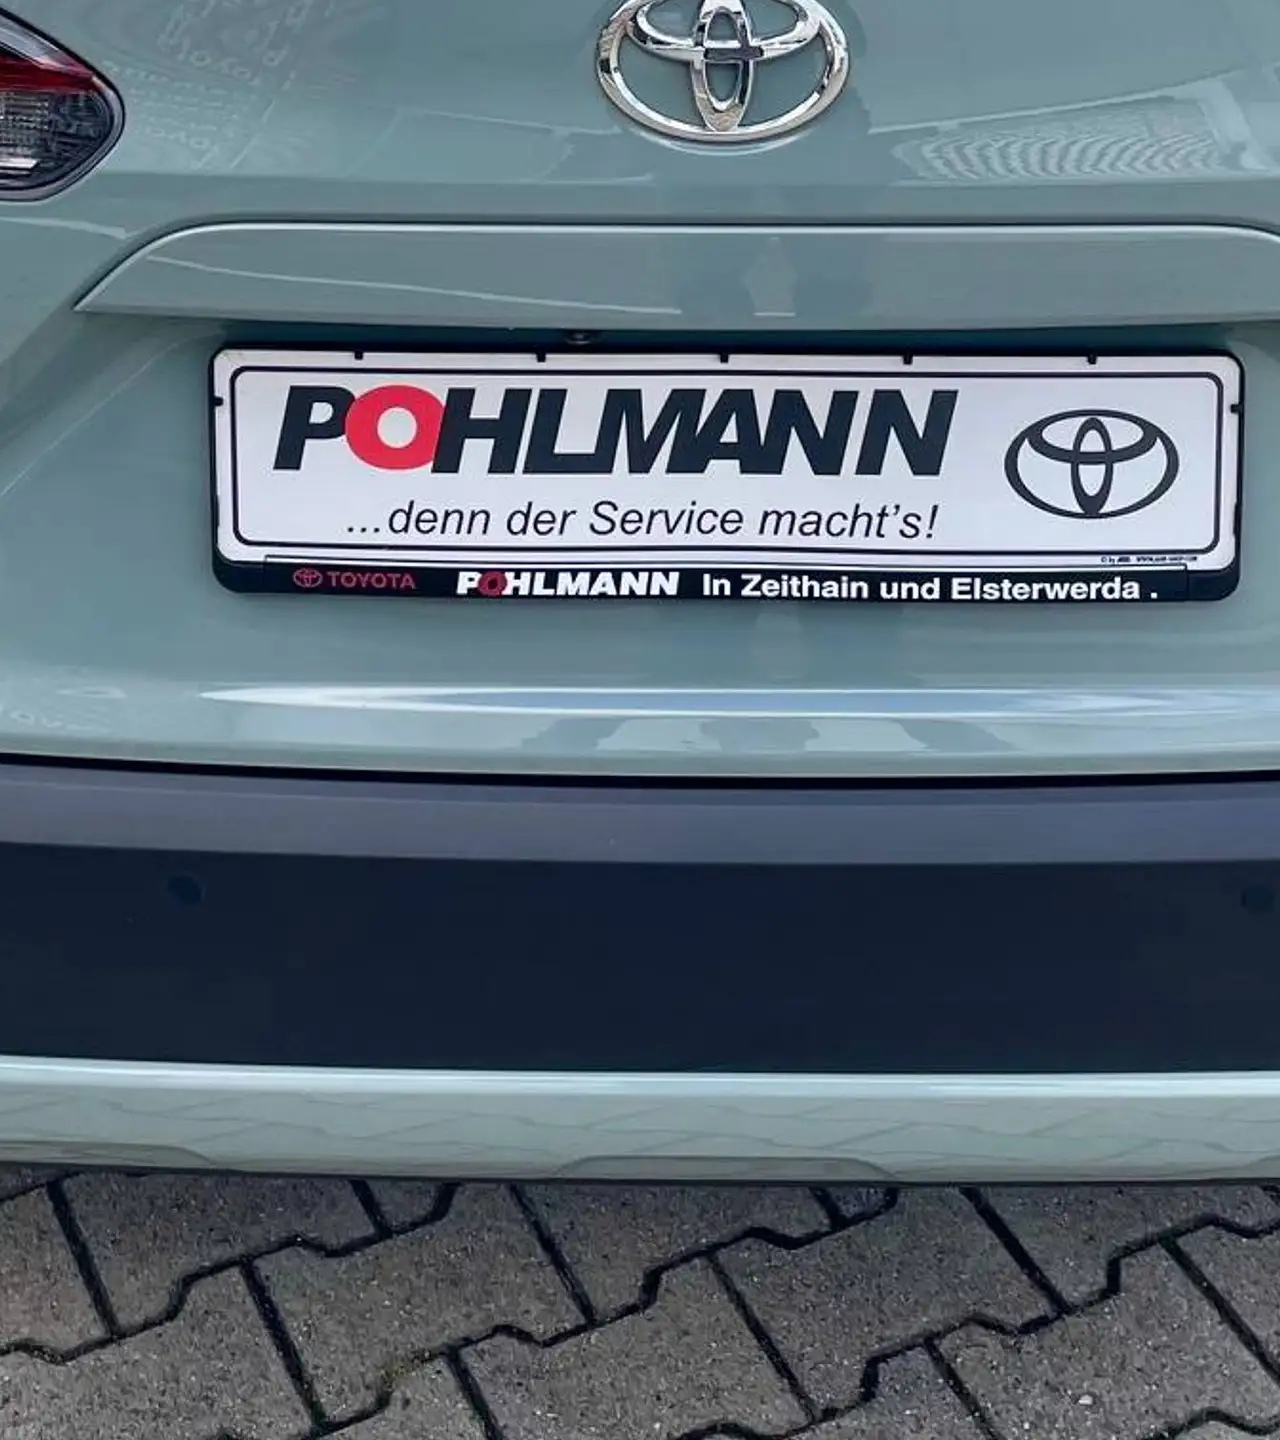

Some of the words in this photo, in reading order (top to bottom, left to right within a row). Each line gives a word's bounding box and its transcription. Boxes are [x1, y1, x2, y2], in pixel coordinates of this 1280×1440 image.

[273, 384, 958, 476] POHLMANN
[506, 501, 577, 536] der
[589, 500, 744, 536] Service
[326, 571, 416, 590] TOYOTA
[456, 571, 680, 596] POHLMANN
[703, 573, 731, 596] In
[740, 573, 869, 599] Zeithain
[880, 576, 938, 600] und
[951, 576, 1140, 601] Elsterwerda
